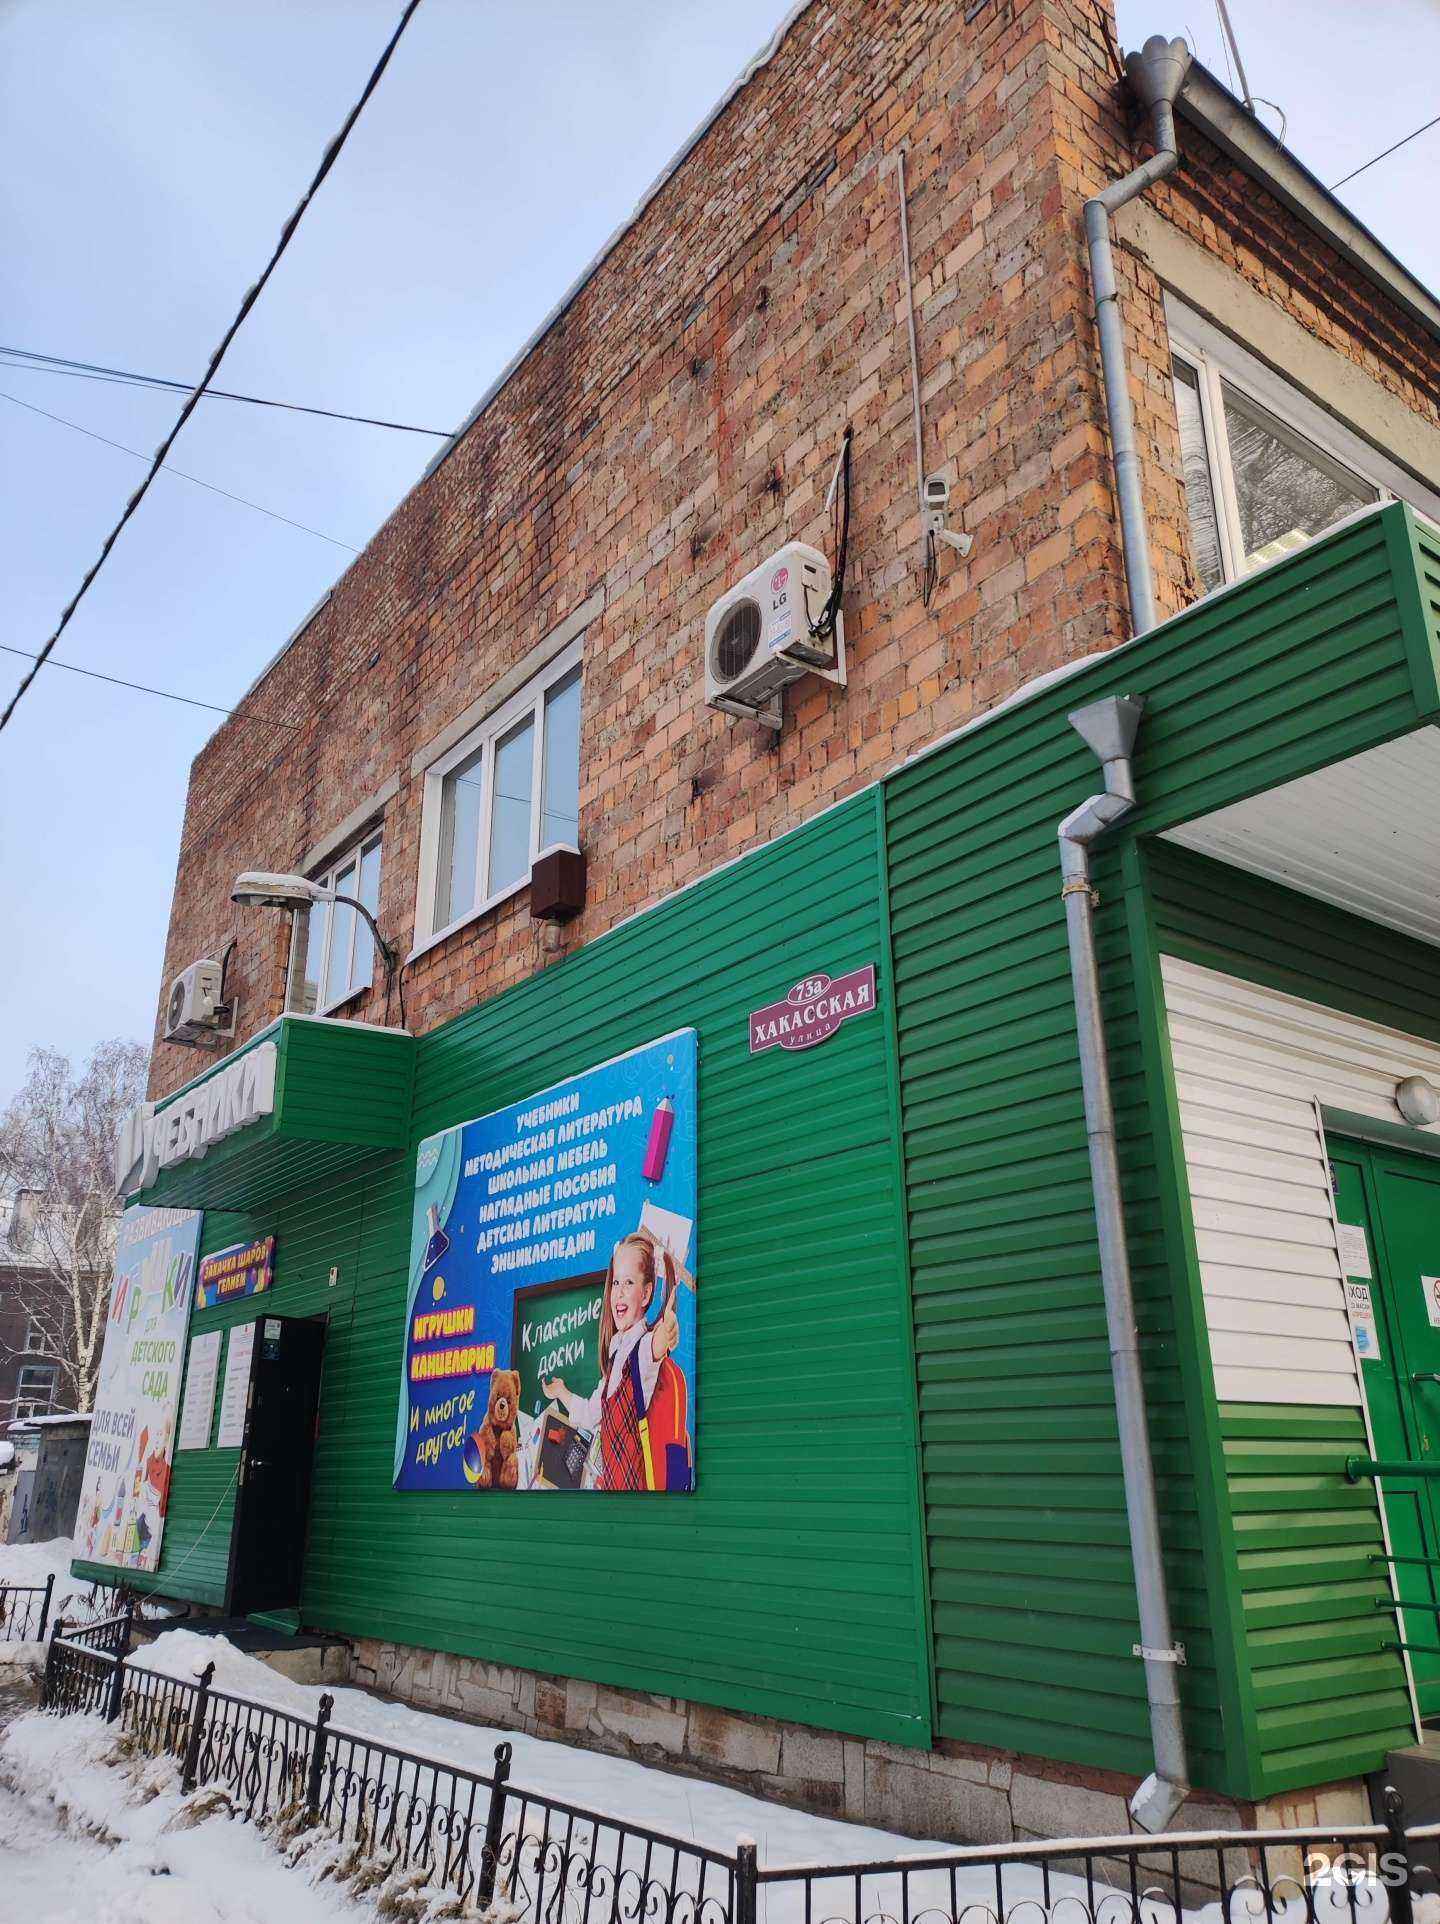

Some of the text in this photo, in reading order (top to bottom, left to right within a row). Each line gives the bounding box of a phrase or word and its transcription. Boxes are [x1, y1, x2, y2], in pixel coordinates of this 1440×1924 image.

[773, 593, 787, 610] LG
[796, 980, 822, 1000] 73а
[755, 984, 870, 1043] ХАКАССКАЯ
[516, 1092, 580, 1133] УЧЕБНИКИ
[464, 1096, 643, 1178] МЕТОДИЧЕСКАЯ ЛИТЕРАТУРА
[488, 1139, 608, 1195] ШКОЛЬНАЯ МЕБЕЛЬ
[479, 1163, 616, 1223] НАГЛЯДНЫЕ ПОСОБИЯ
[476, 1194, 616, 1253] ДЕТСКАЯ ЛИТЕРАТУРА
[204, 1244, 266, 1281] ЗАКАЧКА ШАРОВ
[490, 1230, 595, 1274] ЭНЦИКЛОПЕДИИ
[216, 1270, 246, 1294] ГЕЛИЕМ
[414, 1306, 475, 1341] ИГРУШКИ
[521, 1298, 602, 1352] Классные
[130, 1341, 176, 1366] ДЕТСКОГО
[411, 1345, 495, 1381] КАНЦЕЛЯРИЯ
[142, 1371, 168, 1401] САДА
[92, 1408, 135, 1438] ДЛЯ ВСЕЙ
[410, 1403, 418, 1433] И
[88, 1441, 121, 1473] СЕМЬИ
